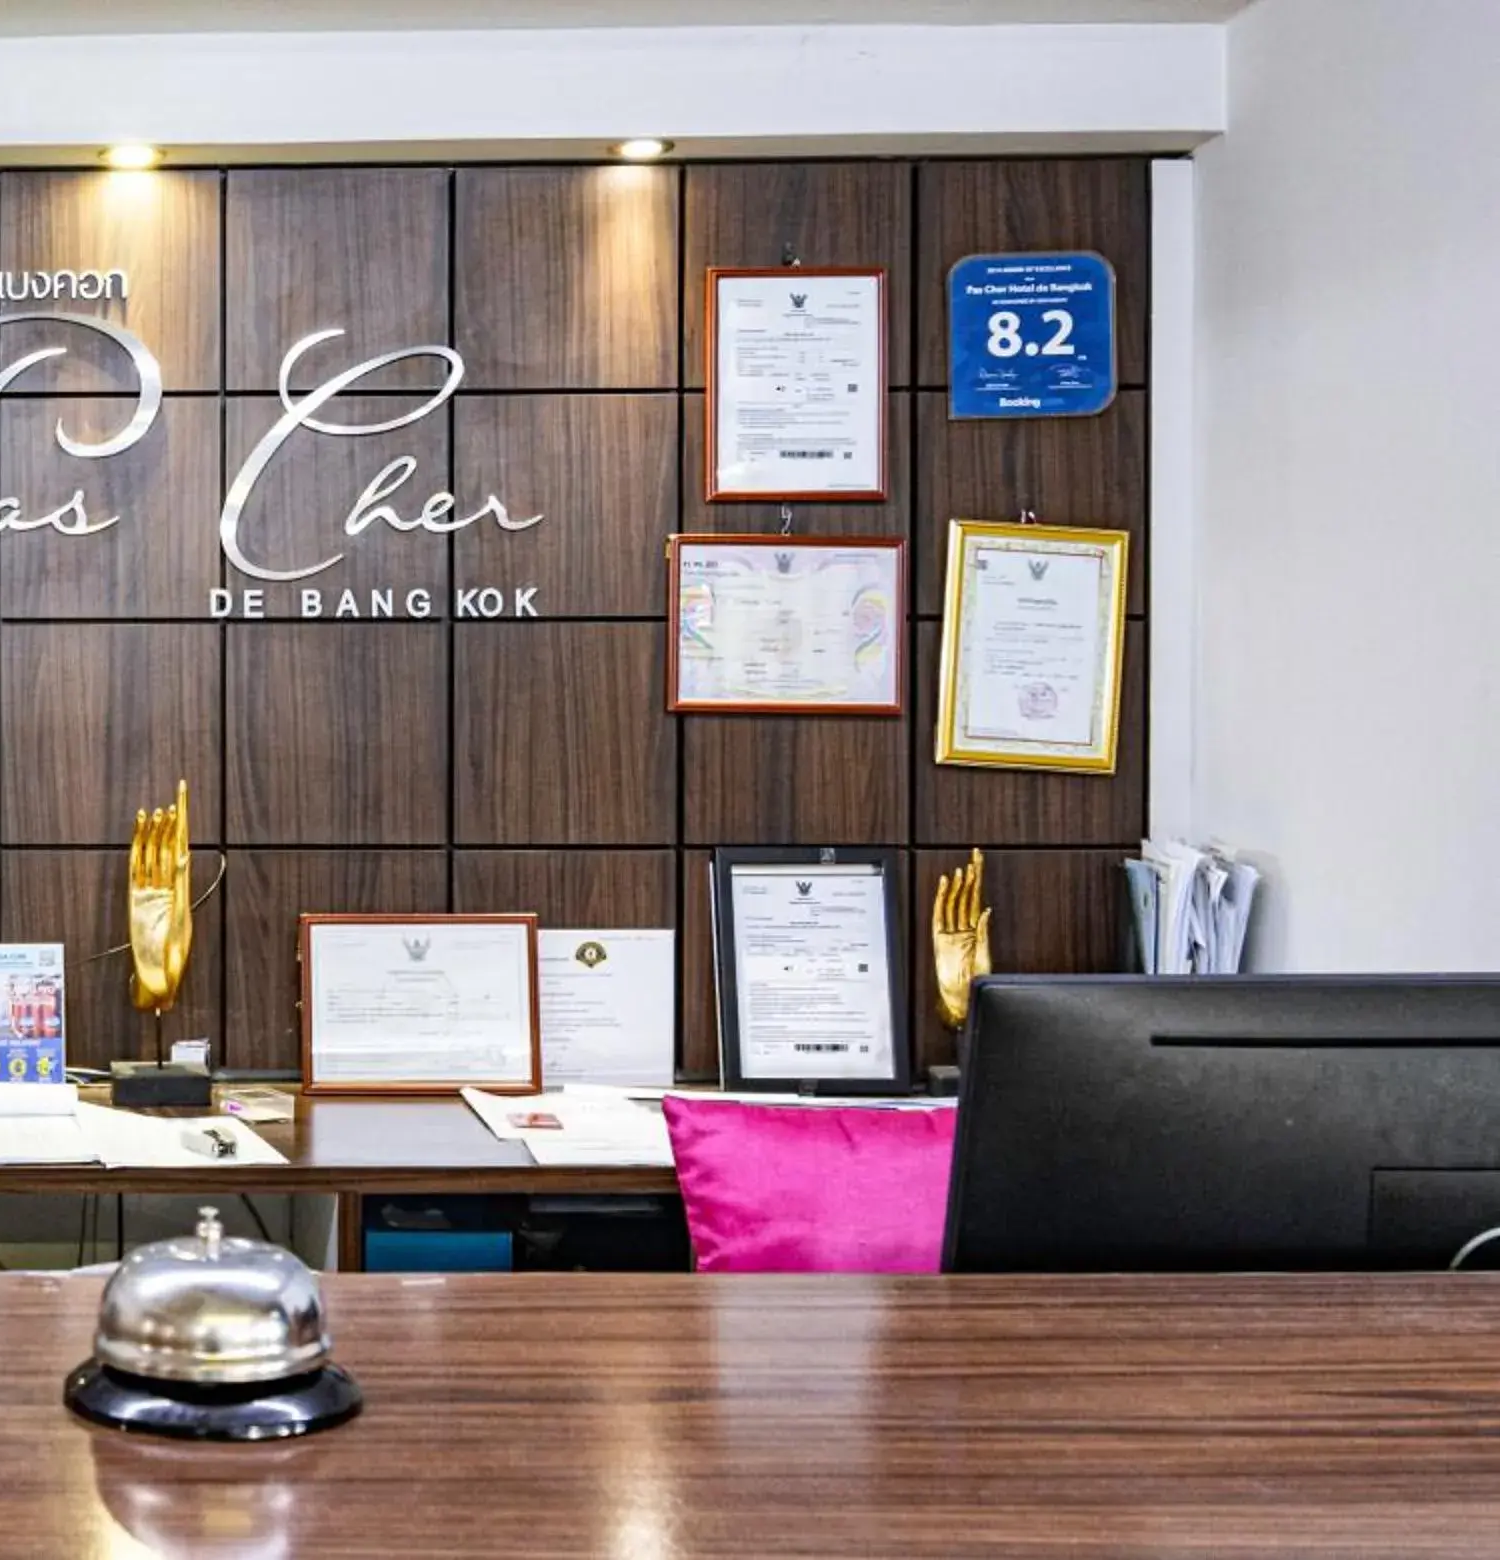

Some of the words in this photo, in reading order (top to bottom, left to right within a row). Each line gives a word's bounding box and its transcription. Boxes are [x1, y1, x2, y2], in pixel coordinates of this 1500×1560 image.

[987, 309, 1075, 357] 8.2
[220, 329, 544, 581] Cher
[209, 589, 264, 618] DE
